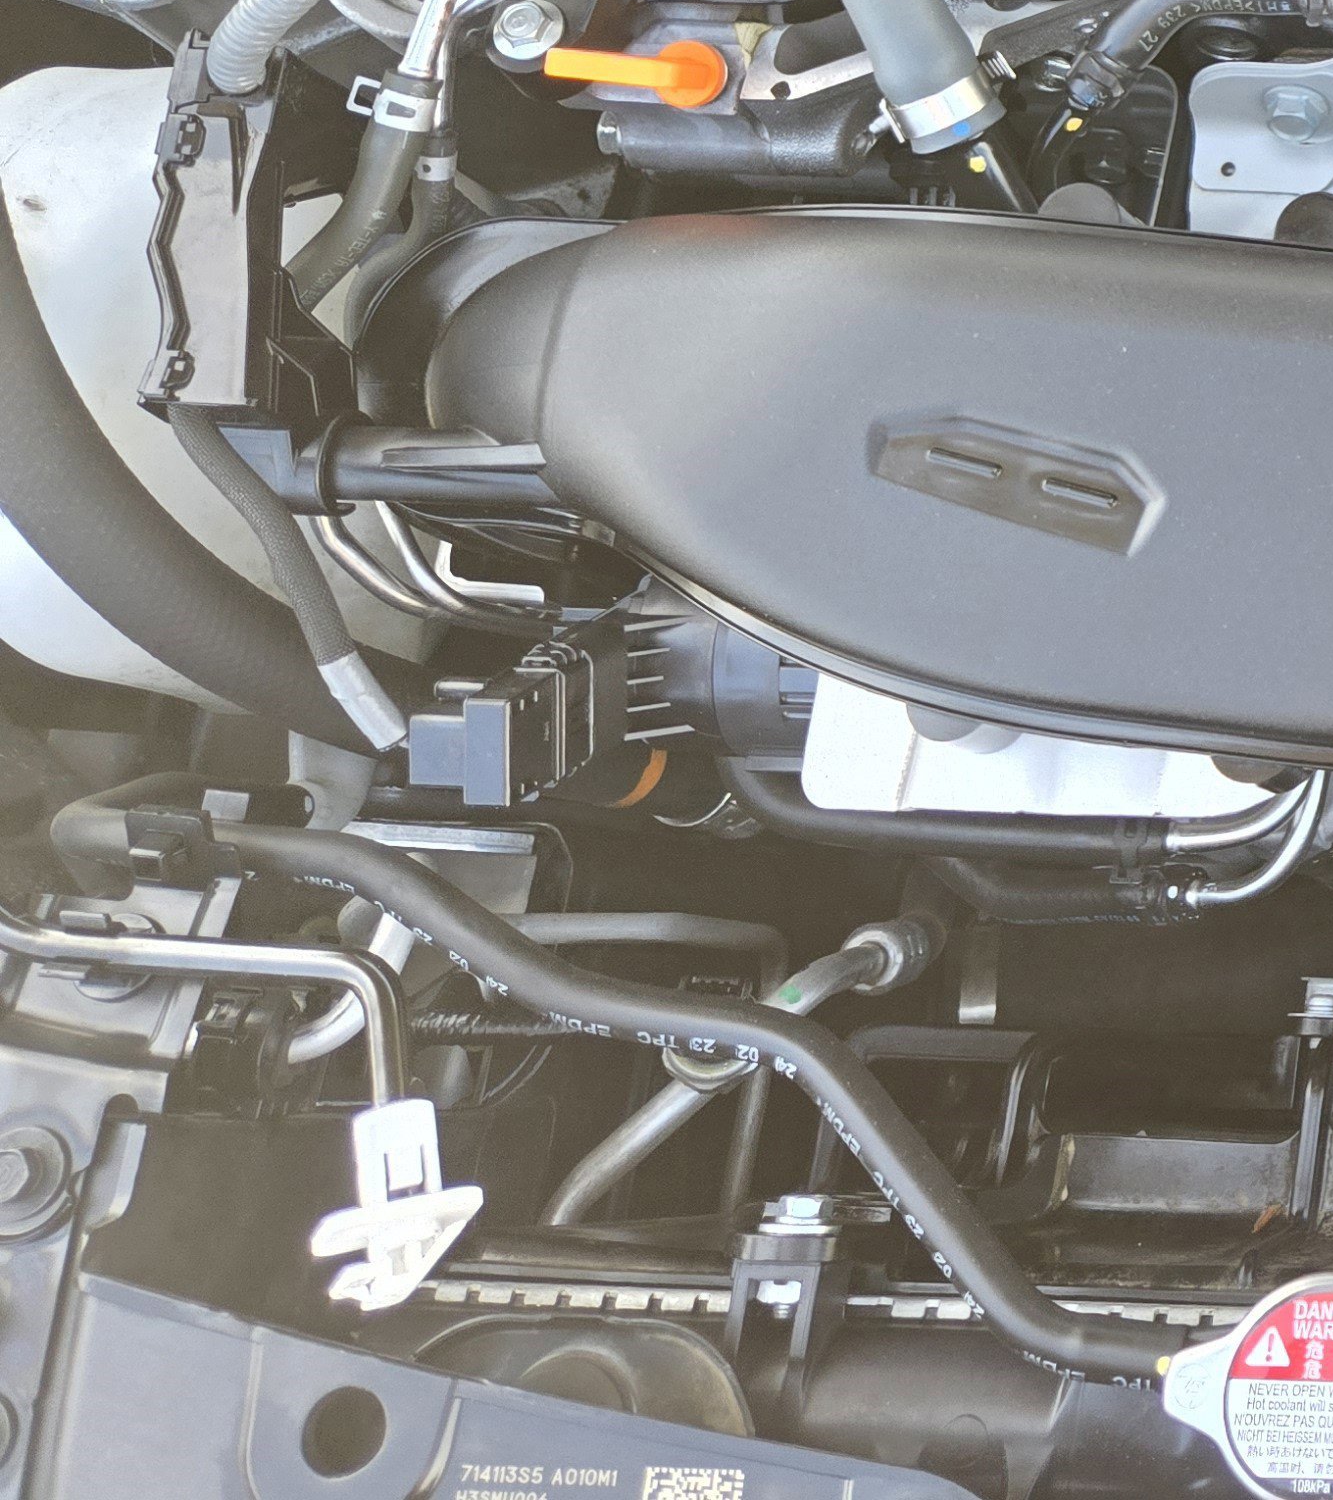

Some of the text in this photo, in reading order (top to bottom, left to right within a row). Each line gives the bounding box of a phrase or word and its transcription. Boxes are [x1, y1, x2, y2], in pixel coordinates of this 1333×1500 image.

[549, 1011, 612, 1038] EPDM
[636, 1031, 680, 1049] TPC
[1248, 1383, 1289, 1397] NEVER
[1292, 1384, 1325, 1398] OPEN
[1246, 1398, 1266, 1411] Hot
[1268, 1399, 1306, 1412] coolant
[1309, 1400, 1325, 1412] will
[1234, 1413, 1291, 1427] N'OUVREZ
[1293, 1414, 1315, 1428] PAS
[1237, 1430, 1263, 1442] NICHT
[1266, 1430, 1281, 1443] BEI
[1292, 1479, 1331, 1494] 108kPa
